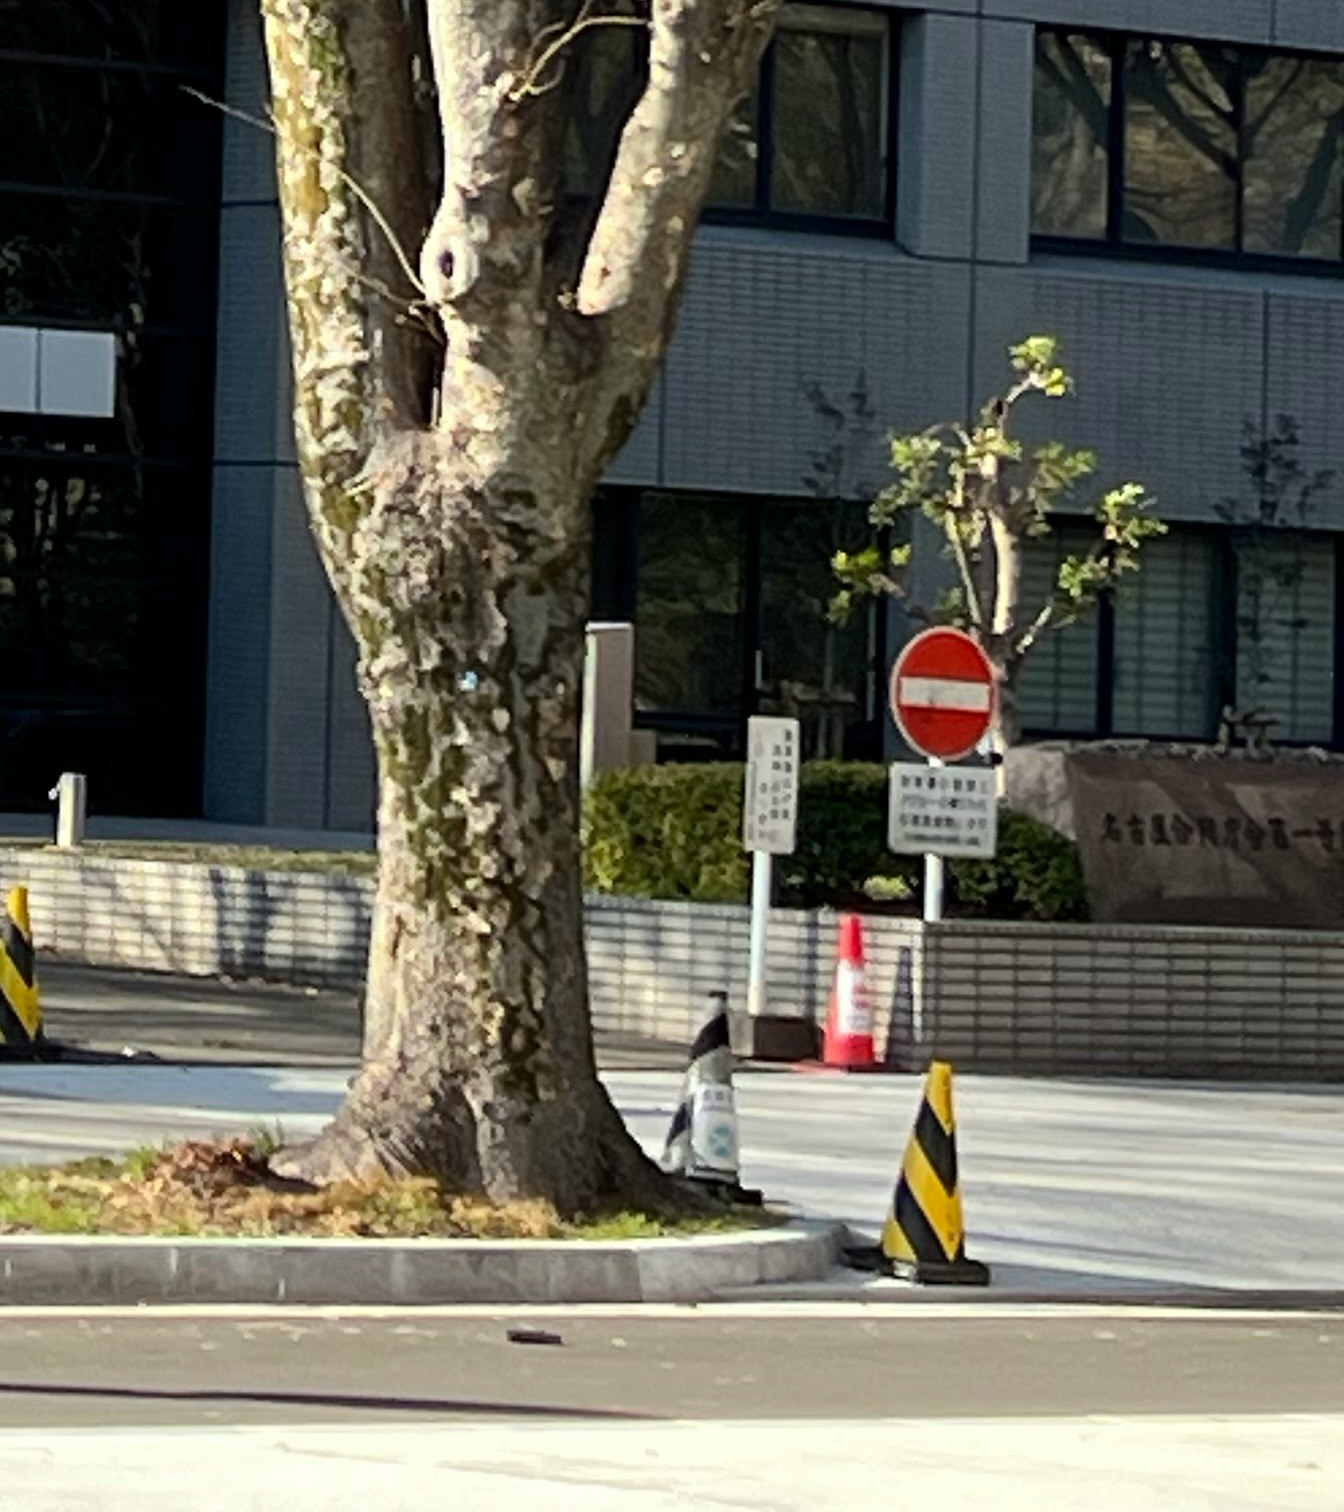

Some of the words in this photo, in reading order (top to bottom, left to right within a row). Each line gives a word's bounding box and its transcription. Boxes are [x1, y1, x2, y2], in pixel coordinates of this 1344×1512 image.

[1100, 812, 1344, 852] 名古屋合同庁舎第一号
